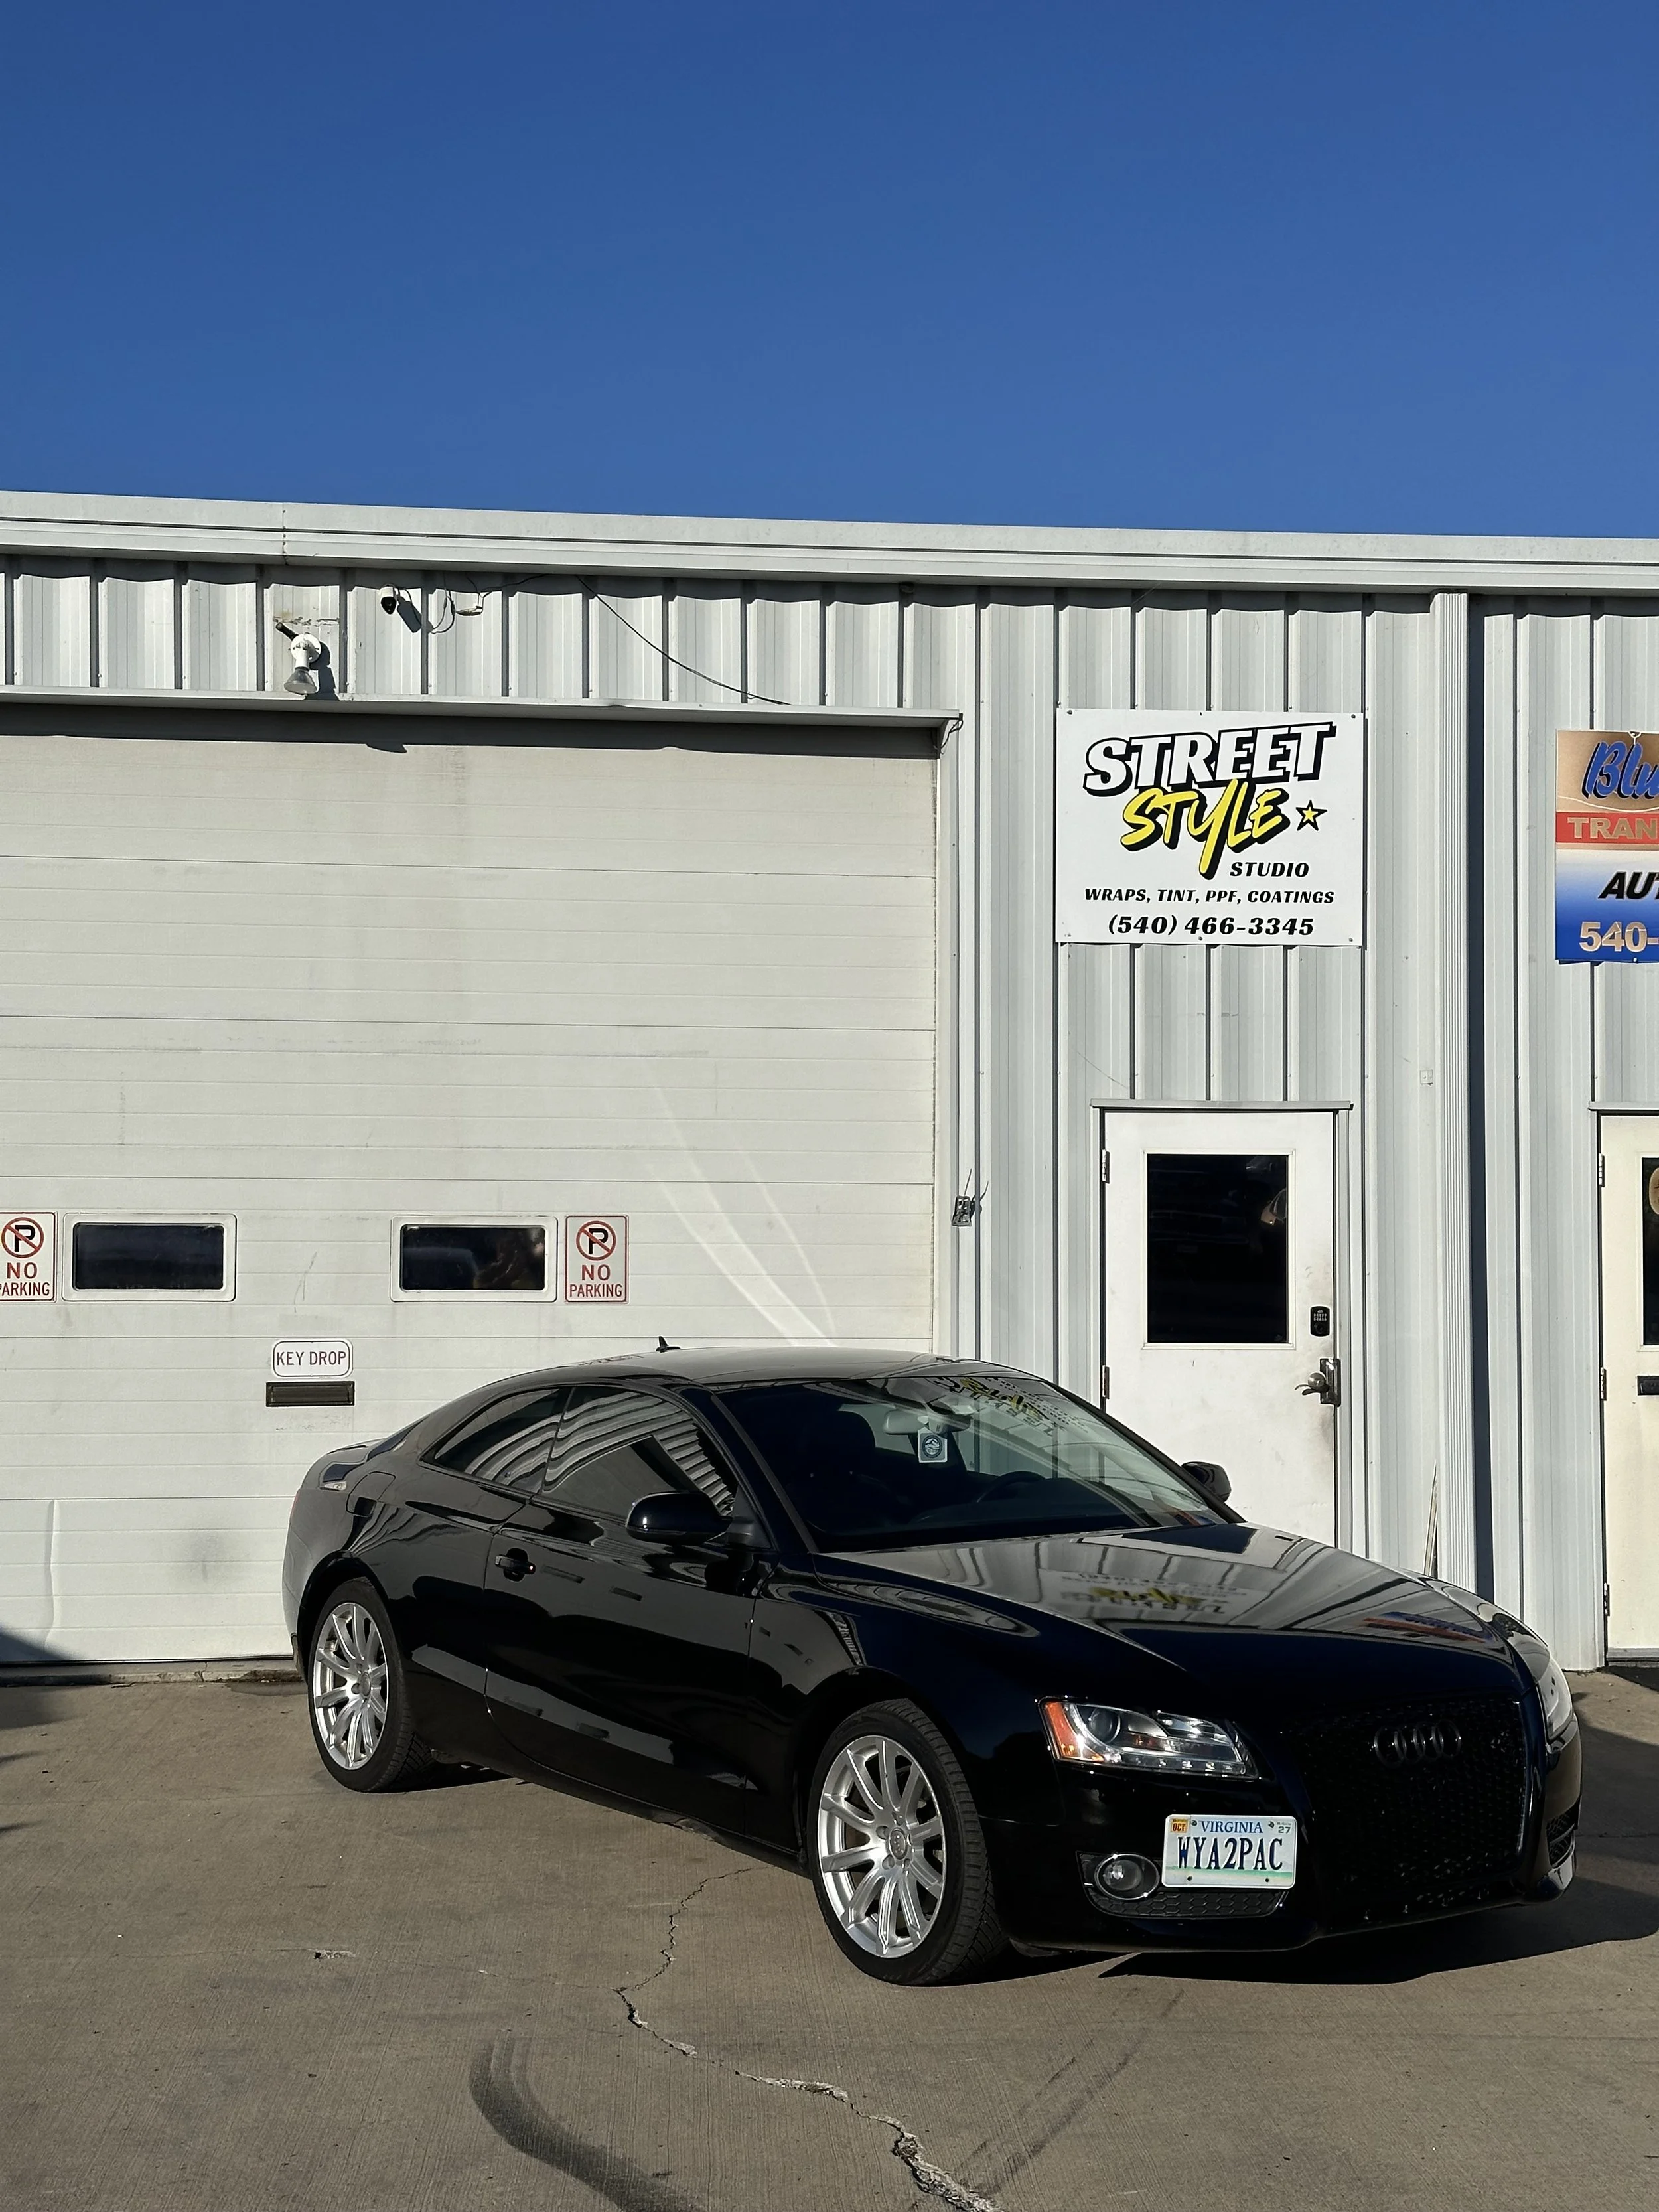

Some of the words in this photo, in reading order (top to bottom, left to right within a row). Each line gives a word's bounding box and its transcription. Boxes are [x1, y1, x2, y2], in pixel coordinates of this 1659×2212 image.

[1083, 721, 1336, 797] STREET
[1120, 779, 1290, 880] STYLE
[1567, 817, 1657, 840] TRAN
[1230, 862, 1309, 877] STUDIO
[1084, 889, 1151, 903] WRAPS,
[1157, 889, 1200, 904] TINT,
[1205, 890, 1241, 904] PPF,
[1247, 890, 1334, 904] COATINGS
[1108, 915, 1177, 935] (540)
[1184, 917, 1314, 936] 466-3345
[1579, 921, 1659, 952] 540-
[7, 1262, 38, 1279] NO
[581, 1264, 611, 1281] NO
[569, 1284, 622, 1298] PARKING
[277, 1351, 304, 1366] KEY
[309, 1351, 346, 1365] DROP
[1173, 1823, 1186, 1832] OCT
[1202, 1821, 1263, 1834] VIRGINIA
[1177, 1836, 1283, 1870] WYA2PAC
